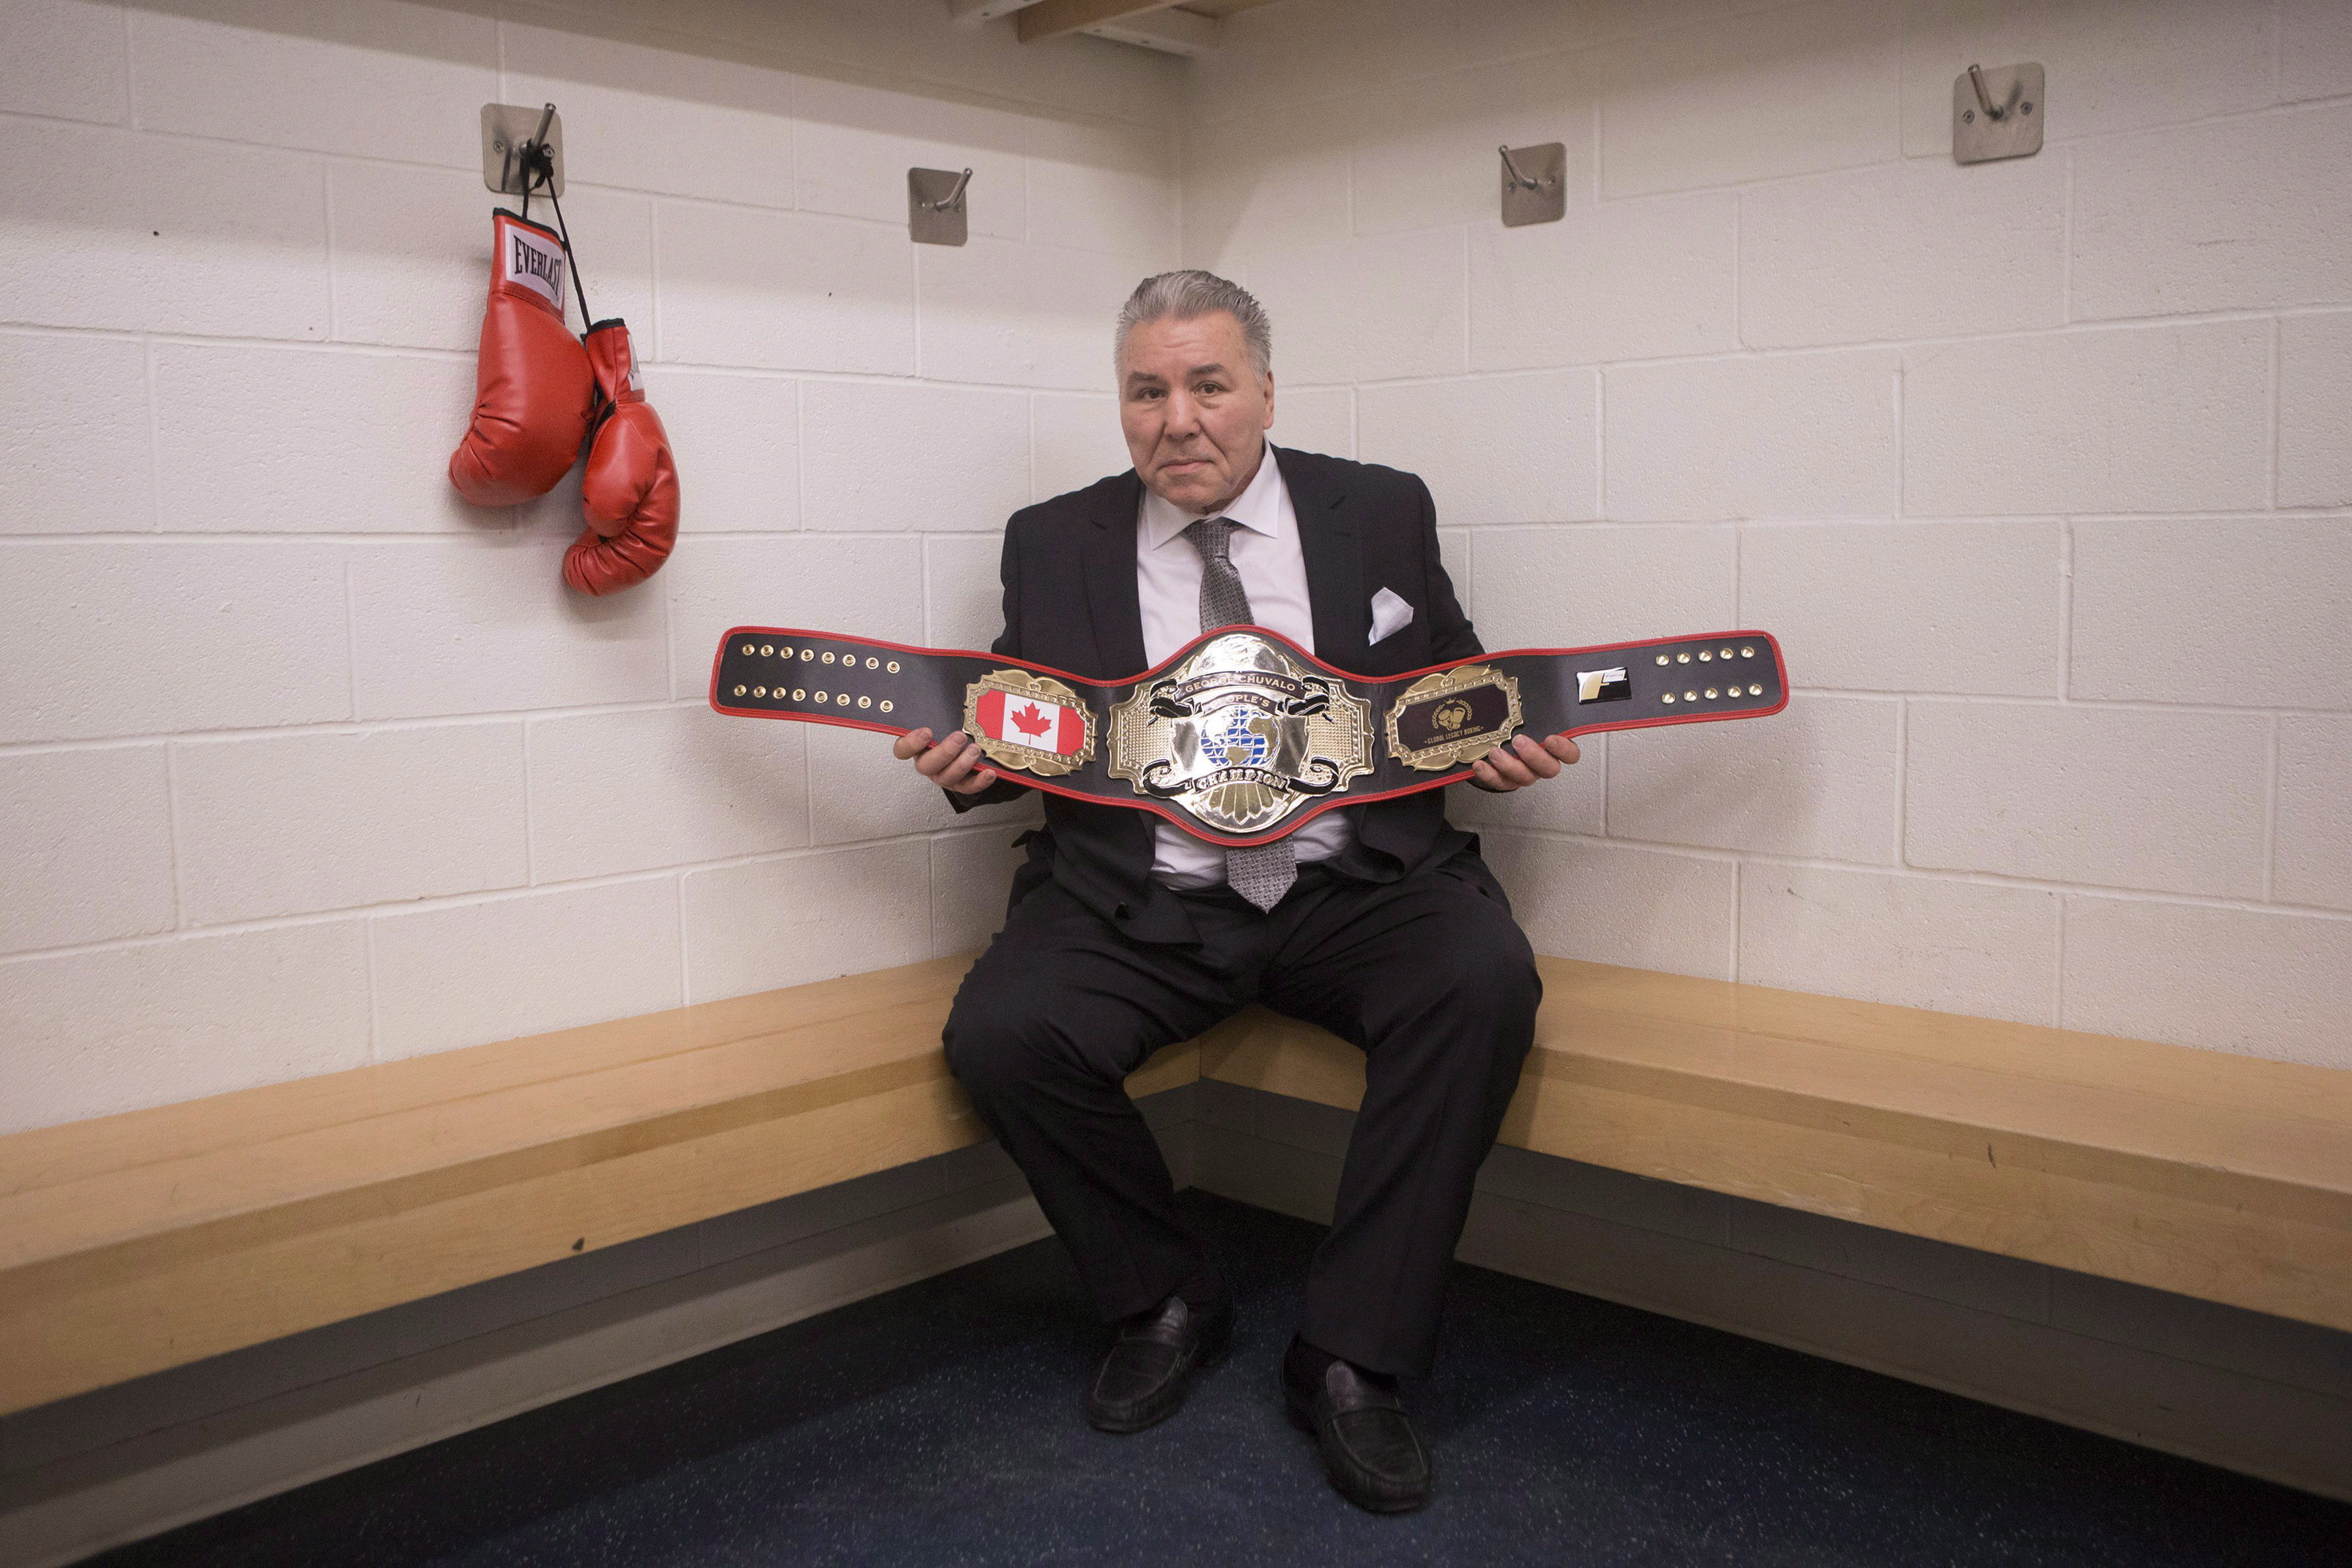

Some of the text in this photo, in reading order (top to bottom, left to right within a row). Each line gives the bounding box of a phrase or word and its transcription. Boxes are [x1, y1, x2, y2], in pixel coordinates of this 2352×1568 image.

[513, 235, 561, 301] EVERLAST
[1185, 676, 1296, 693] GEORGE CHUVALO
[1211, 694, 1270, 708] OPLE'S
[1428, 725, 1481, 744] GLOBAL LEGACY BOXING
[1196, 769, 1286, 790] CHAMPION
